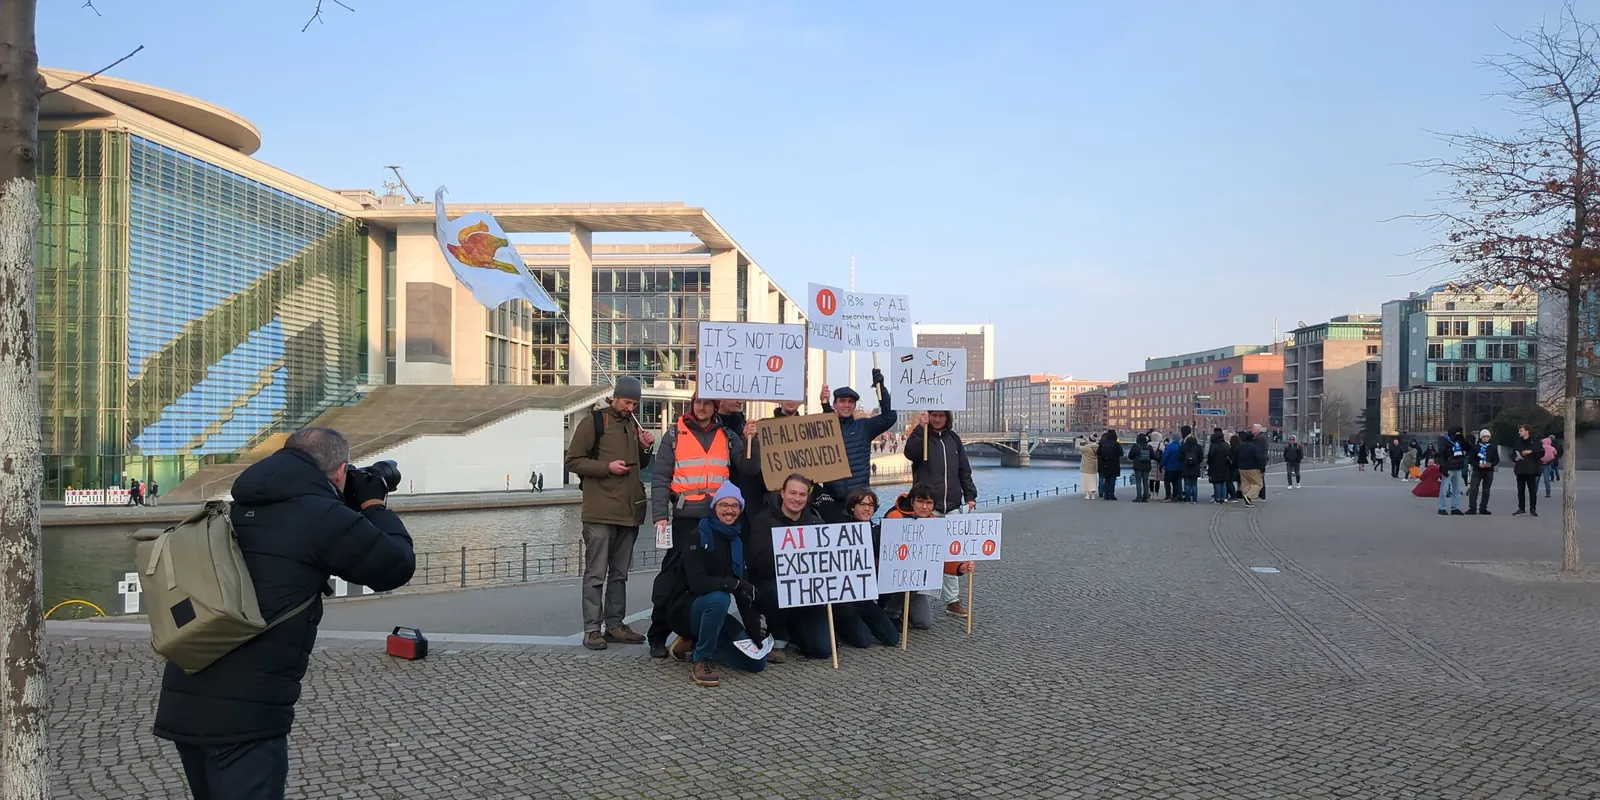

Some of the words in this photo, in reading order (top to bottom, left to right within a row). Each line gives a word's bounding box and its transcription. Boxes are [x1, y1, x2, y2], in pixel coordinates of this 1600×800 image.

[842, 295, 864, 306] 8%
[874, 297, 884, 312] of
[888, 298, 906, 310] AI
[808, 322, 842, 340] PAUSEAI
[868, 322, 877, 331] AI
[880, 322, 900, 330] could
[704, 326, 737, 348] IT'S
[745, 332, 774, 349] NOT
[779, 333, 804, 350] TOO
[848, 334, 860, 346] kill
[866, 338, 880, 347] us
[884, 332, 894, 347] all
[705, 350, 743, 370] LATE
[754, 354, 783, 372] T
[705, 372, 785, 395] REGULATE
[900, 368, 912, 384] AI
[920, 368, 952, 386] Action
[907, 389, 944, 404] Summit
[762, 420, 834, 446] AI-ALIGNMENT
[766, 452, 782, 472] IS
[784, 444, 842, 470] UNSOLVED!
[780, 528, 806, 550] AI
[815, 526, 830, 548] IS
[836, 524, 864, 546] AN
[902, 524, 924, 542] MEHR
[947, 520, 1000, 536] REGULIERT
[963, 540, 978, 556] KI
[776, 548, 872, 576] EXISTENTIAL
[780, 574, 872, 606] THREAT
